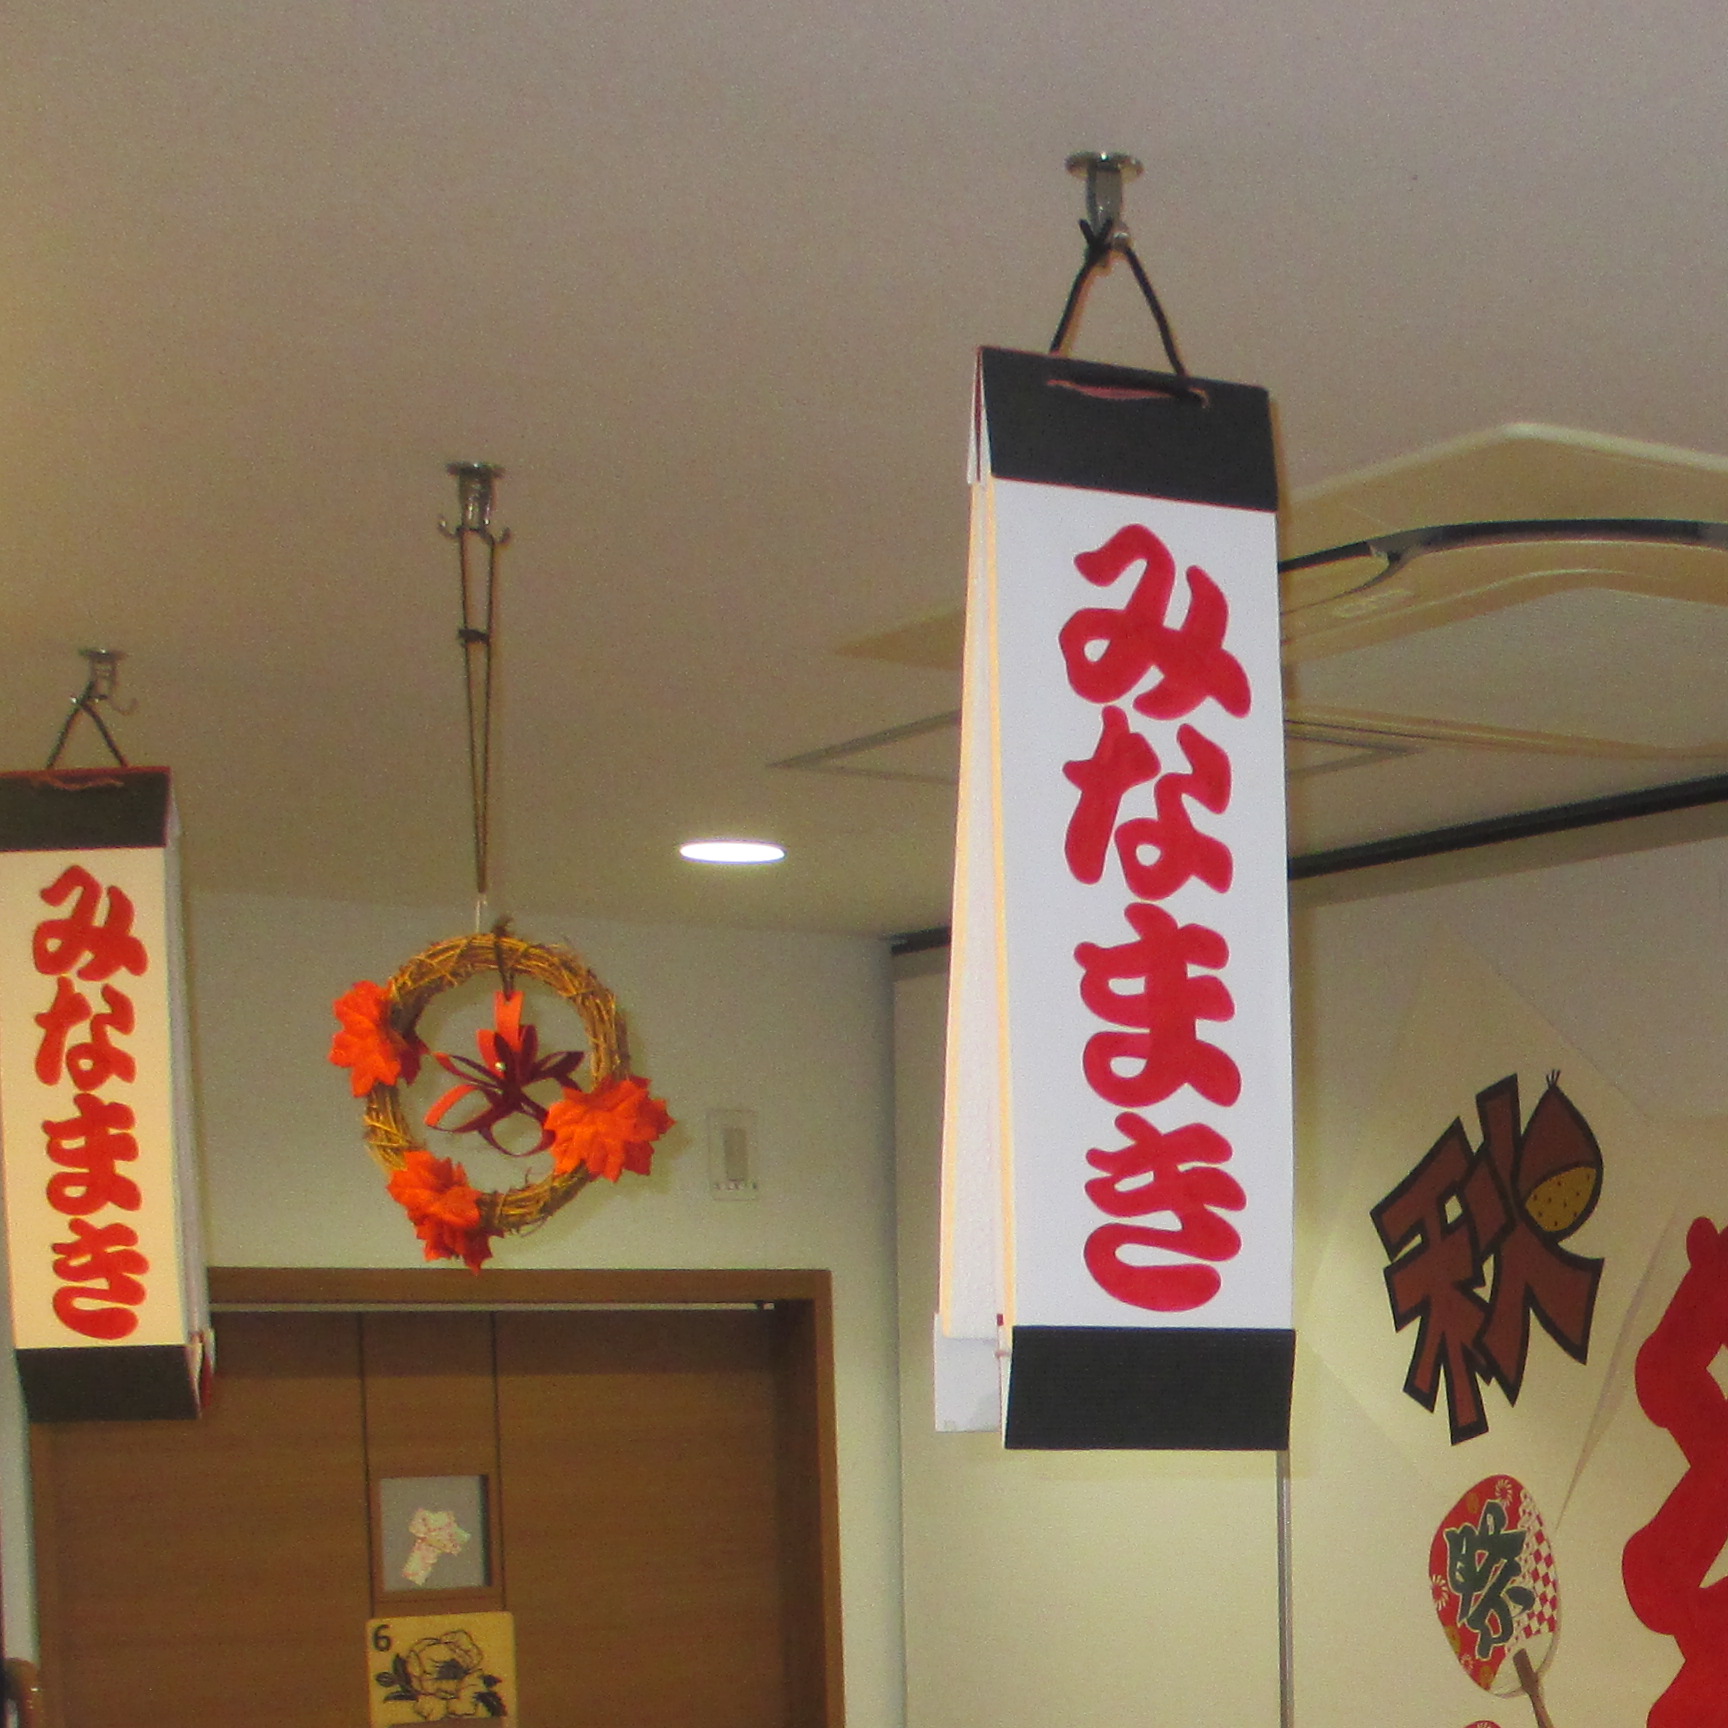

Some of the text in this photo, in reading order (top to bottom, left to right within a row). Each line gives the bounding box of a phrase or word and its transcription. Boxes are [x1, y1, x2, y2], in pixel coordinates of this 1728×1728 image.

[32, 864, 150, 1341] みなまき
[1058, 523, 1252, 1313] みなまき
[1369, 1069, 1606, 1447] 秋
[371, 1623, 394, 1652] 6
